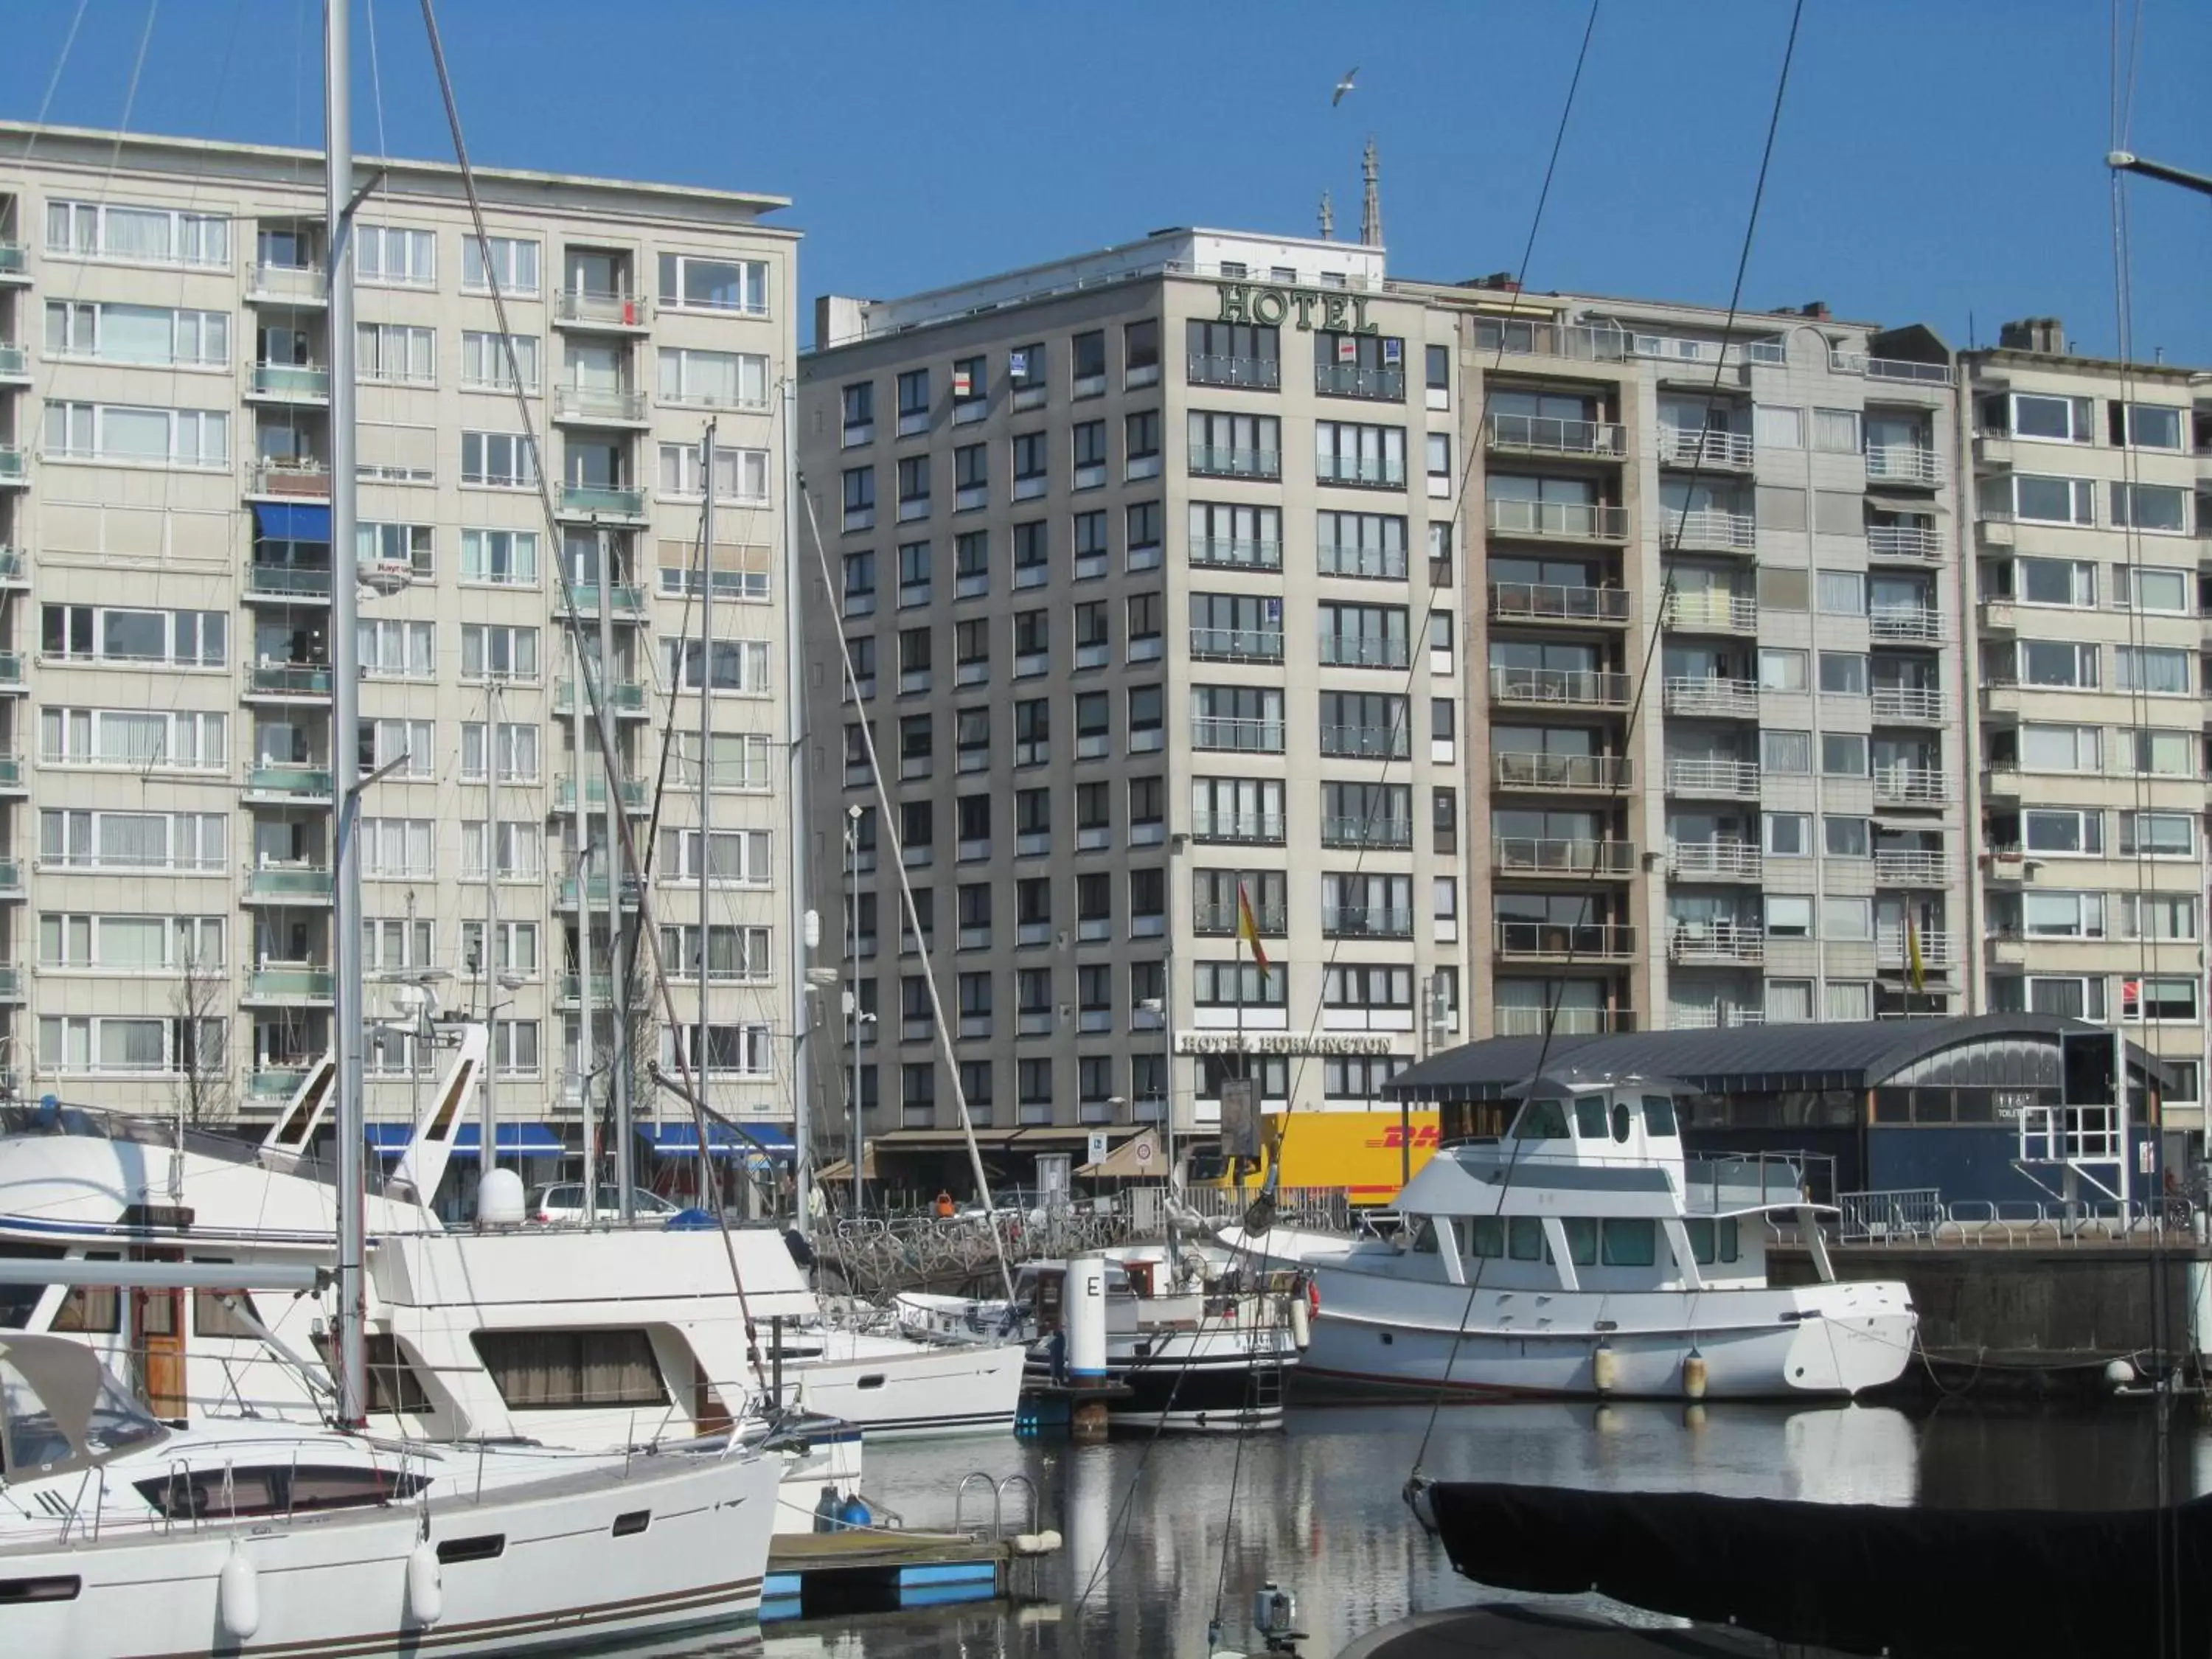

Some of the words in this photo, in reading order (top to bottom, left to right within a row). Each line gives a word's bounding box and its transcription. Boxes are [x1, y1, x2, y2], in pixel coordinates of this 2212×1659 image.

[1217, 283, 1378, 335] HOTEL
[1181, 1034, 1253, 1053] HOTEL
[1382, 1125, 1439, 1147] DH
[1088, 1276, 1100, 1296] E
